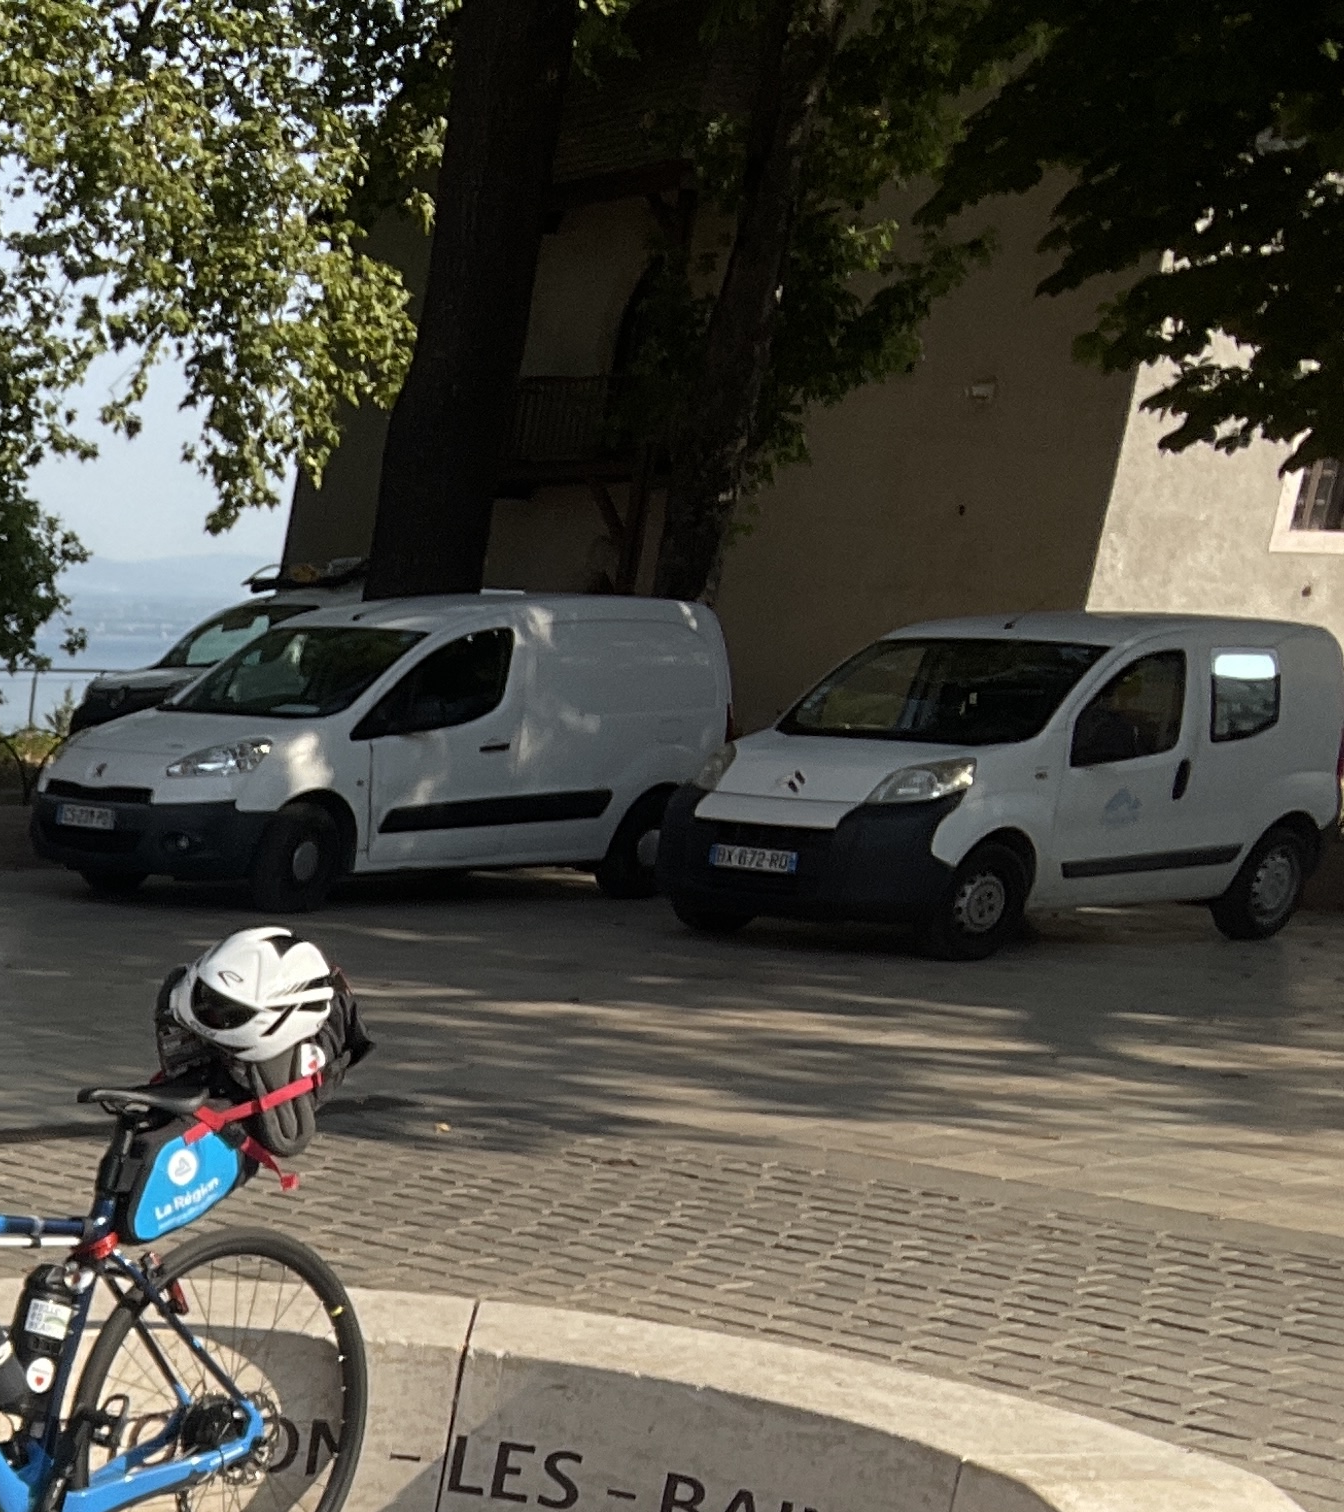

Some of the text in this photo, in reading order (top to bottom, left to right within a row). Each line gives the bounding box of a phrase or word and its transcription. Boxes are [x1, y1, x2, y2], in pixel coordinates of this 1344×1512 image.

[155, 1203, 172, 1220] La
[173, 1177, 219, 1211] Région
[448, 1434, 583, 1511] LES
